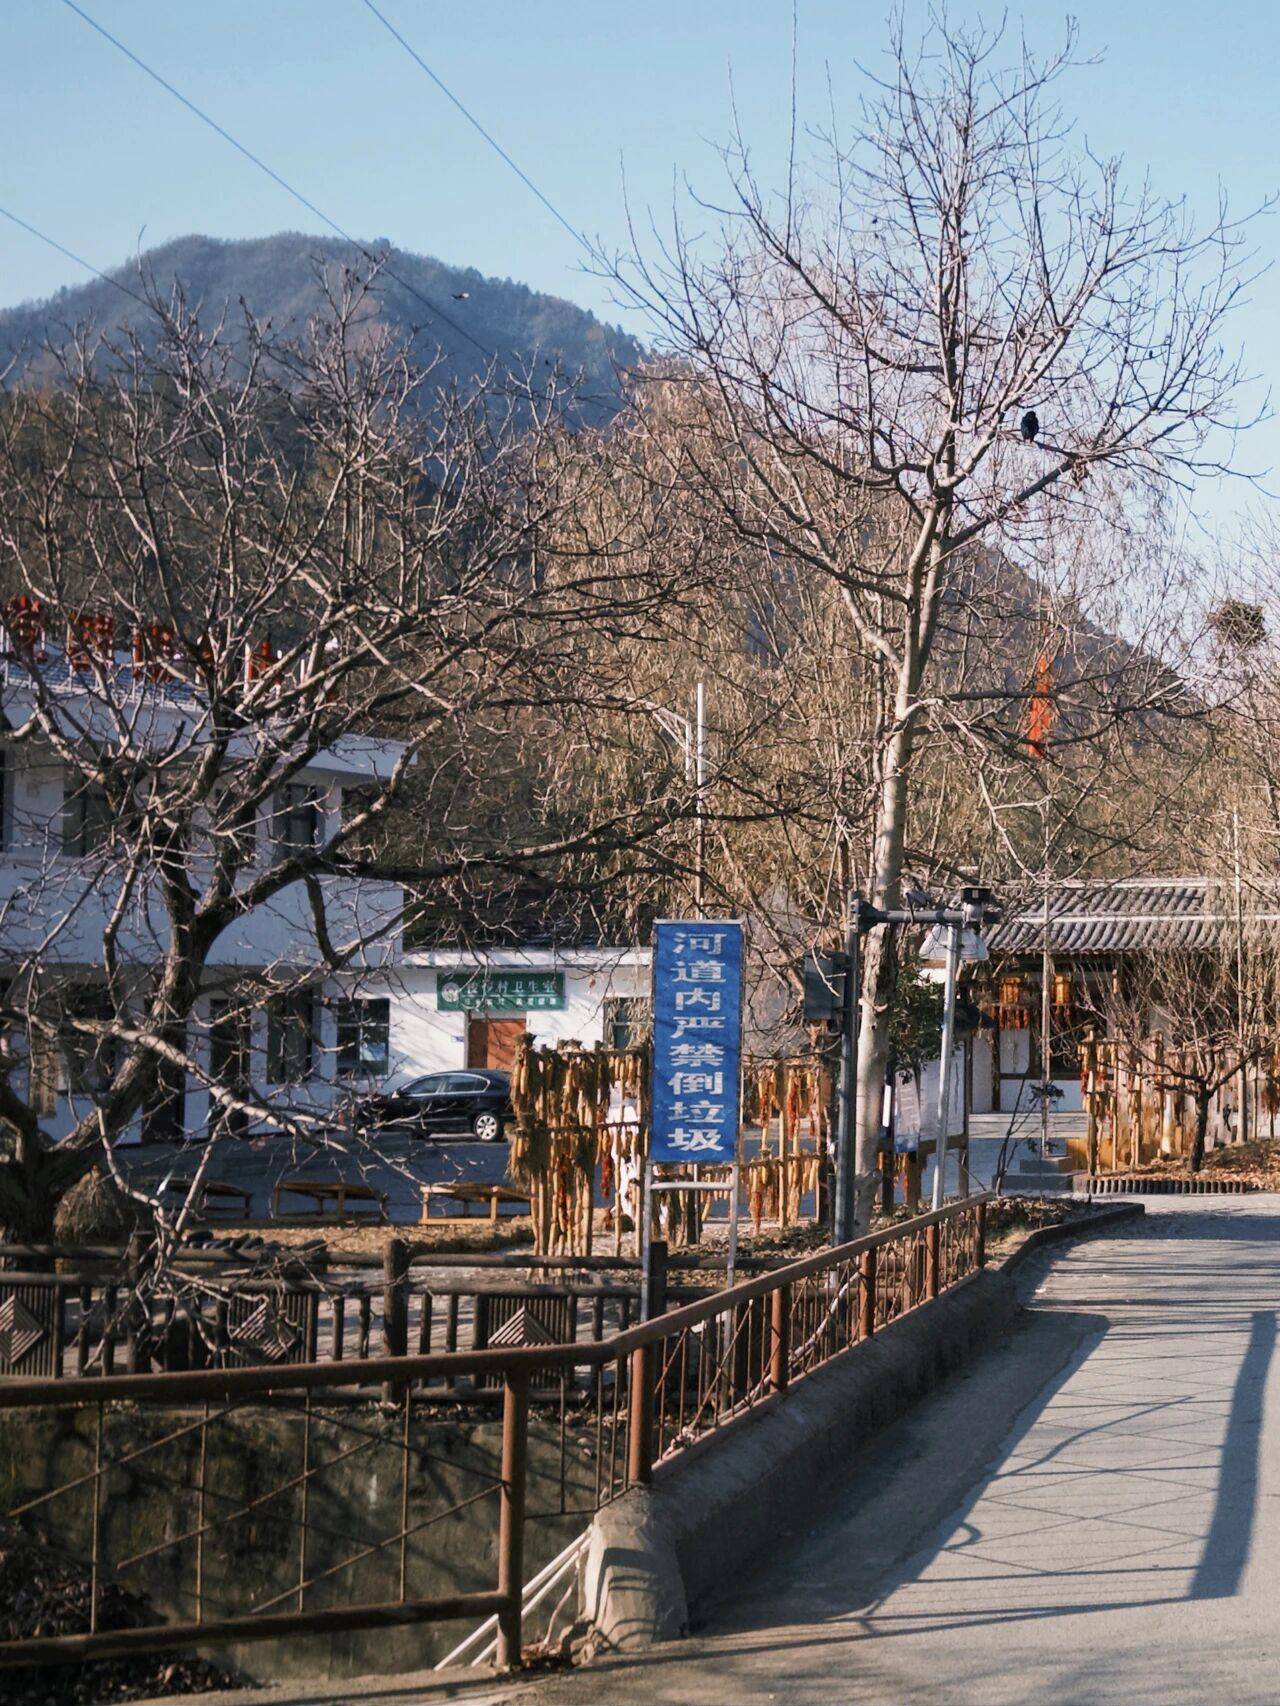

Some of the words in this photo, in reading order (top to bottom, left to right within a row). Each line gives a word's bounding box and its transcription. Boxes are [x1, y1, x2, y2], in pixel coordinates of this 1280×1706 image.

[667, 932, 727, 1152] 河道内严禁倒垃圾
